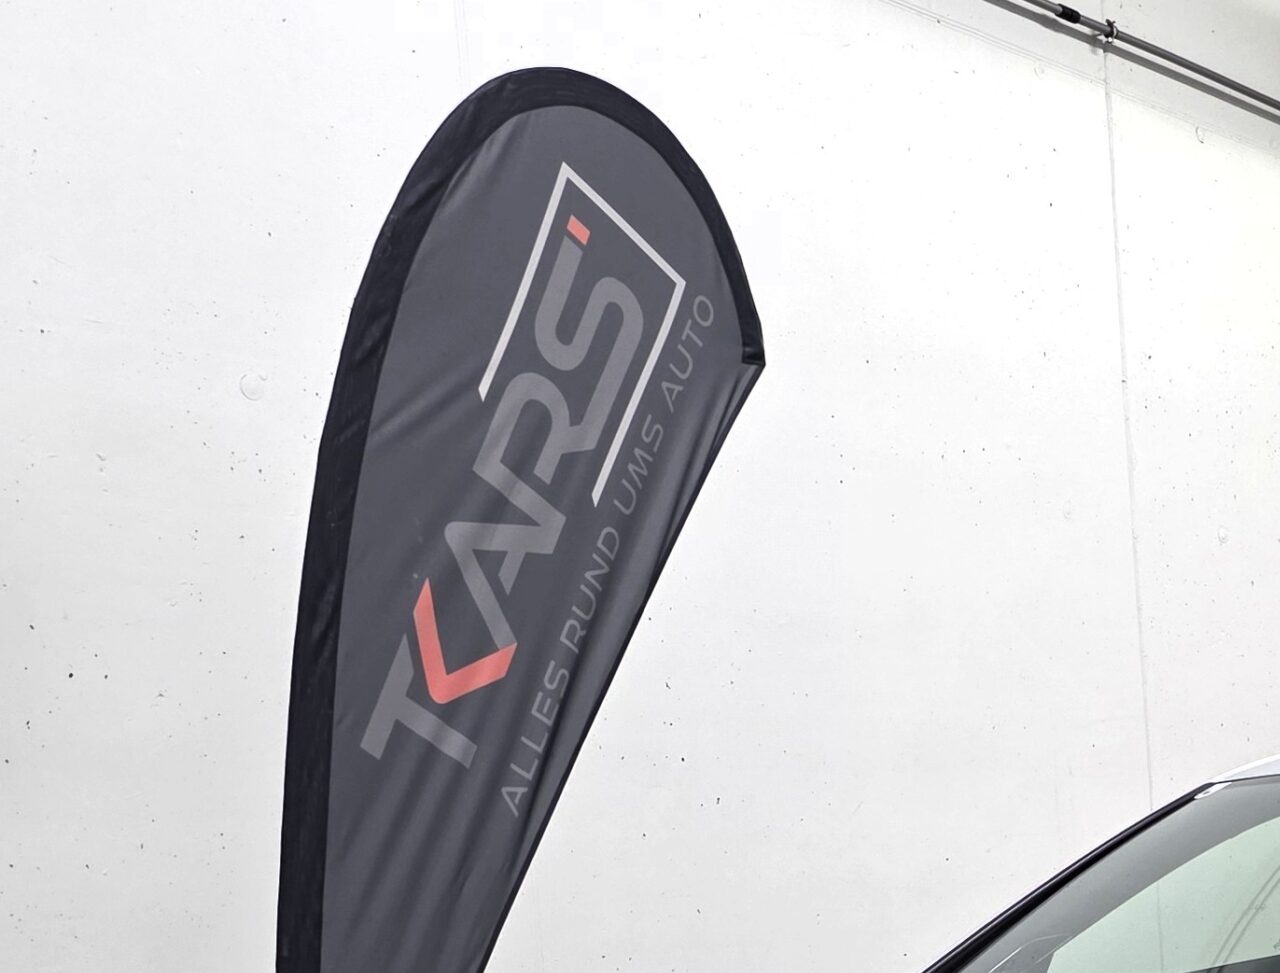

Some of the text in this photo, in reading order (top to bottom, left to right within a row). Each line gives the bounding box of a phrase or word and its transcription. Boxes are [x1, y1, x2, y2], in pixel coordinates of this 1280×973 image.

[501, 295, 715, 815] ALLES RUND UMS AUTO
